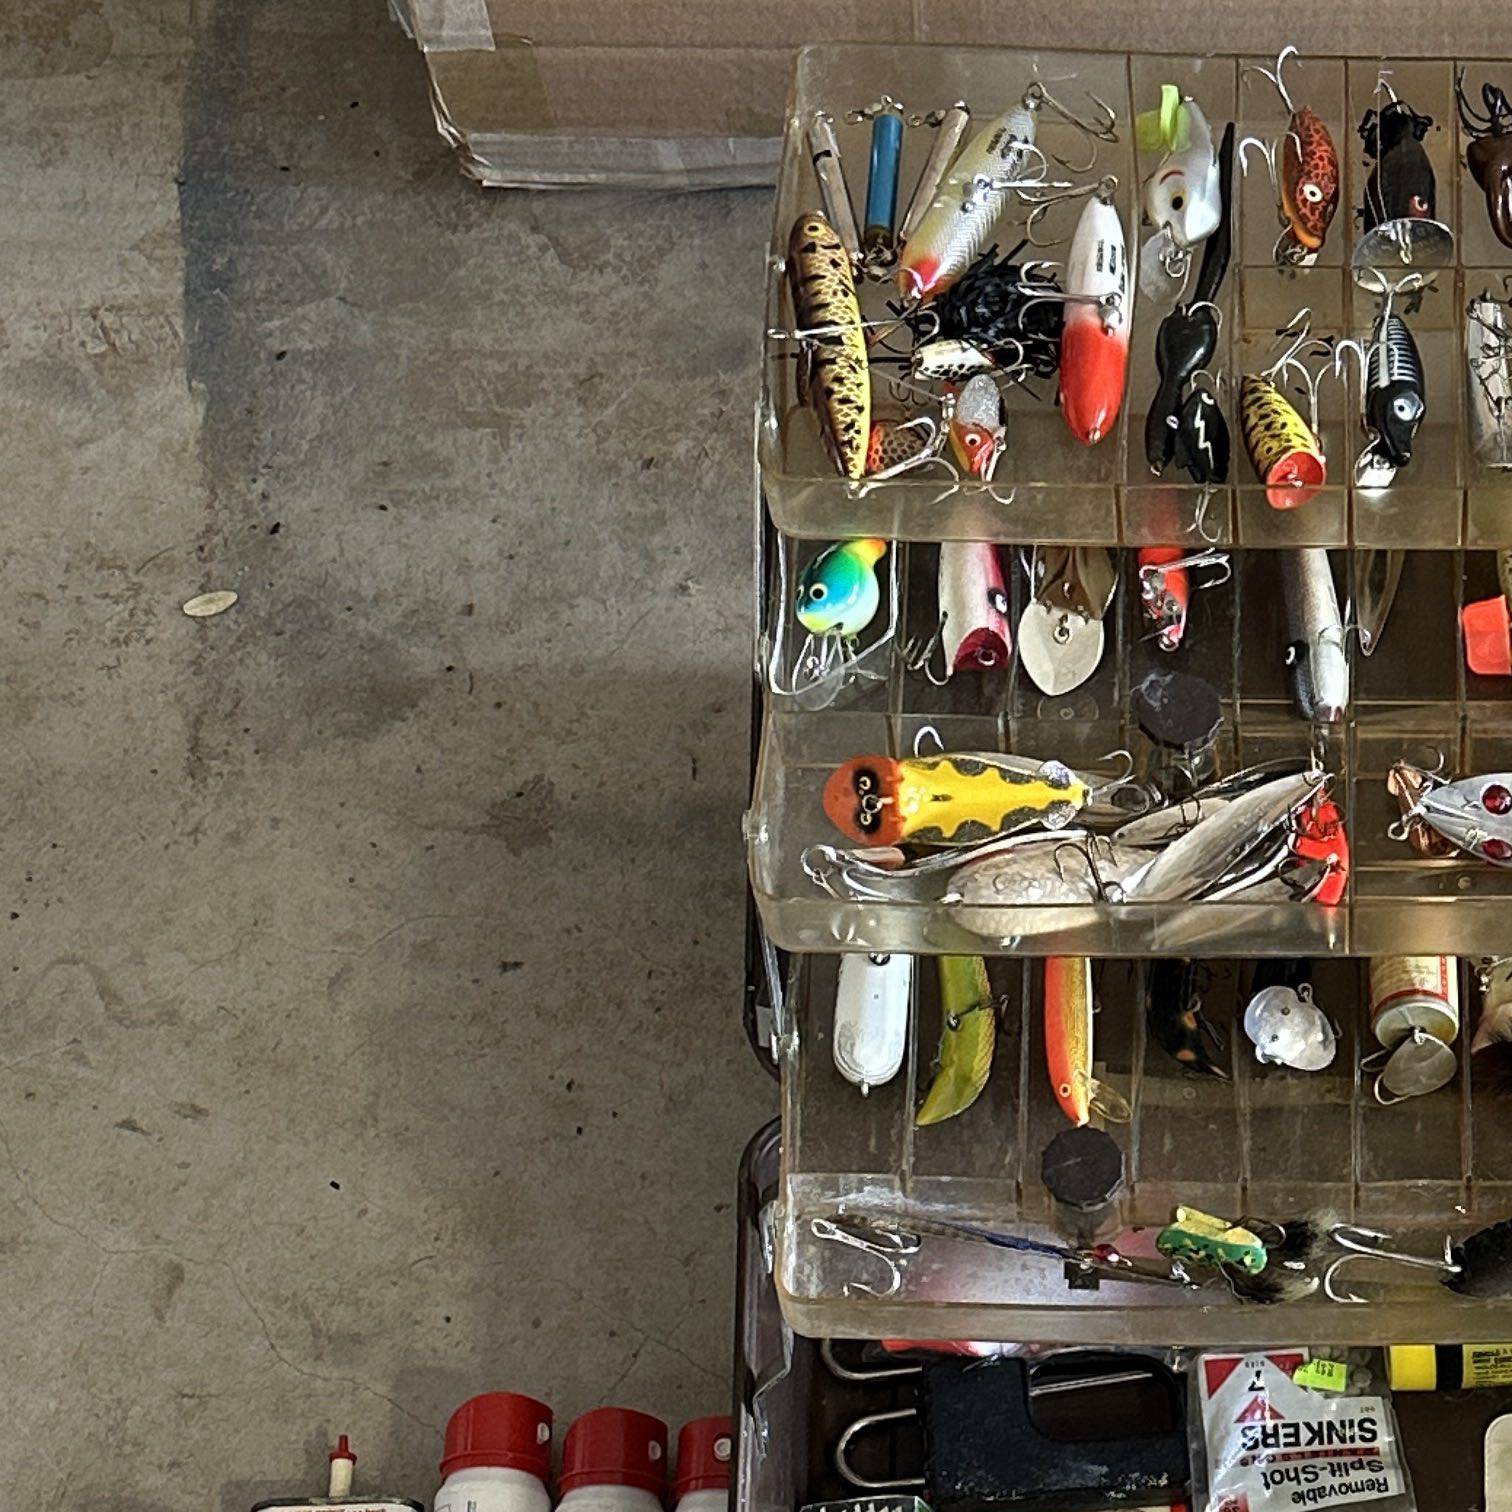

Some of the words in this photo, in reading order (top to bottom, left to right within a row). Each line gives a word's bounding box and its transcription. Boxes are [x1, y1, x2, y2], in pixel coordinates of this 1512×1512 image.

[1240, 1417, 1378, 1451] SINKERS
[1261, 1459, 1385, 1490] Split-Shot
[1291, 1476, 1389, 1506] Removable
